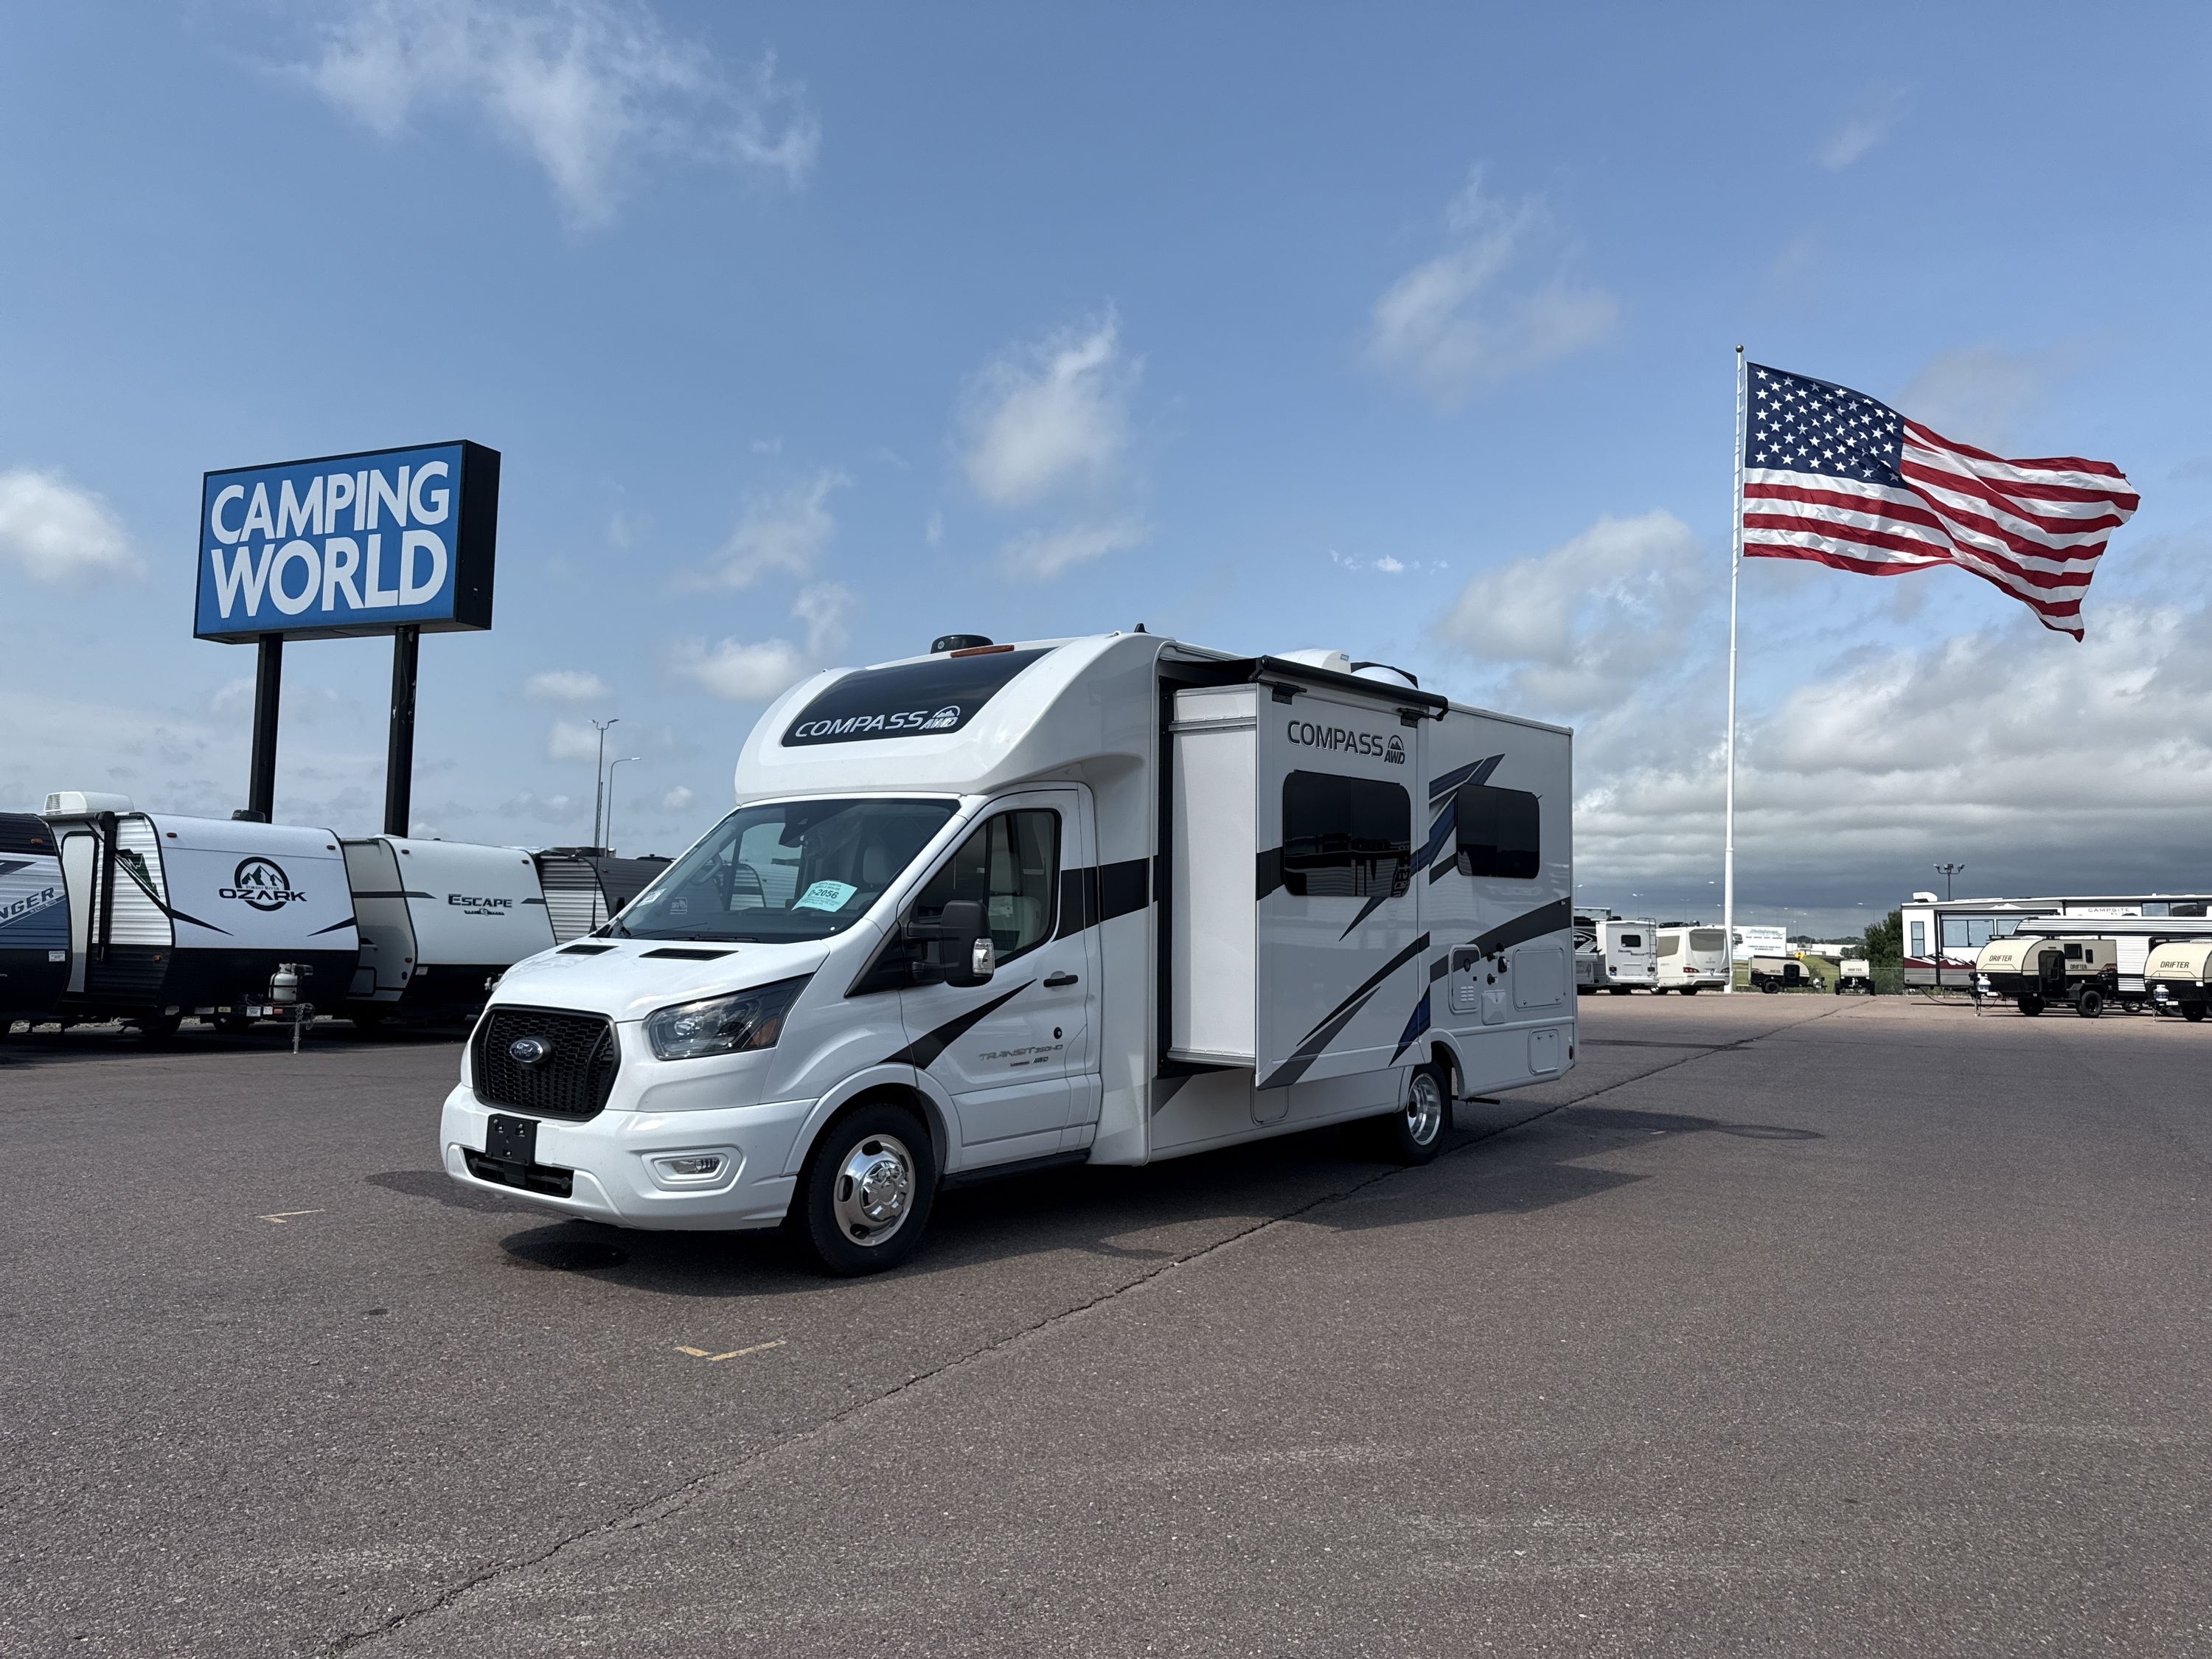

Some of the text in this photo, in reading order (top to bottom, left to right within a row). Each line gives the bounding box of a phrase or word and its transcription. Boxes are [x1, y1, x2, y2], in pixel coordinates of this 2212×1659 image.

[211, 460, 450, 545] CAMPING
[211, 529, 448, 619] WORLD
[795, 710, 959, 738] COMPASS AWD
[1287, 719, 1405, 765] COMPASS AWD
[219, 888, 307, 902] OZARK
[448, 894, 512, 908] ESCAPE
